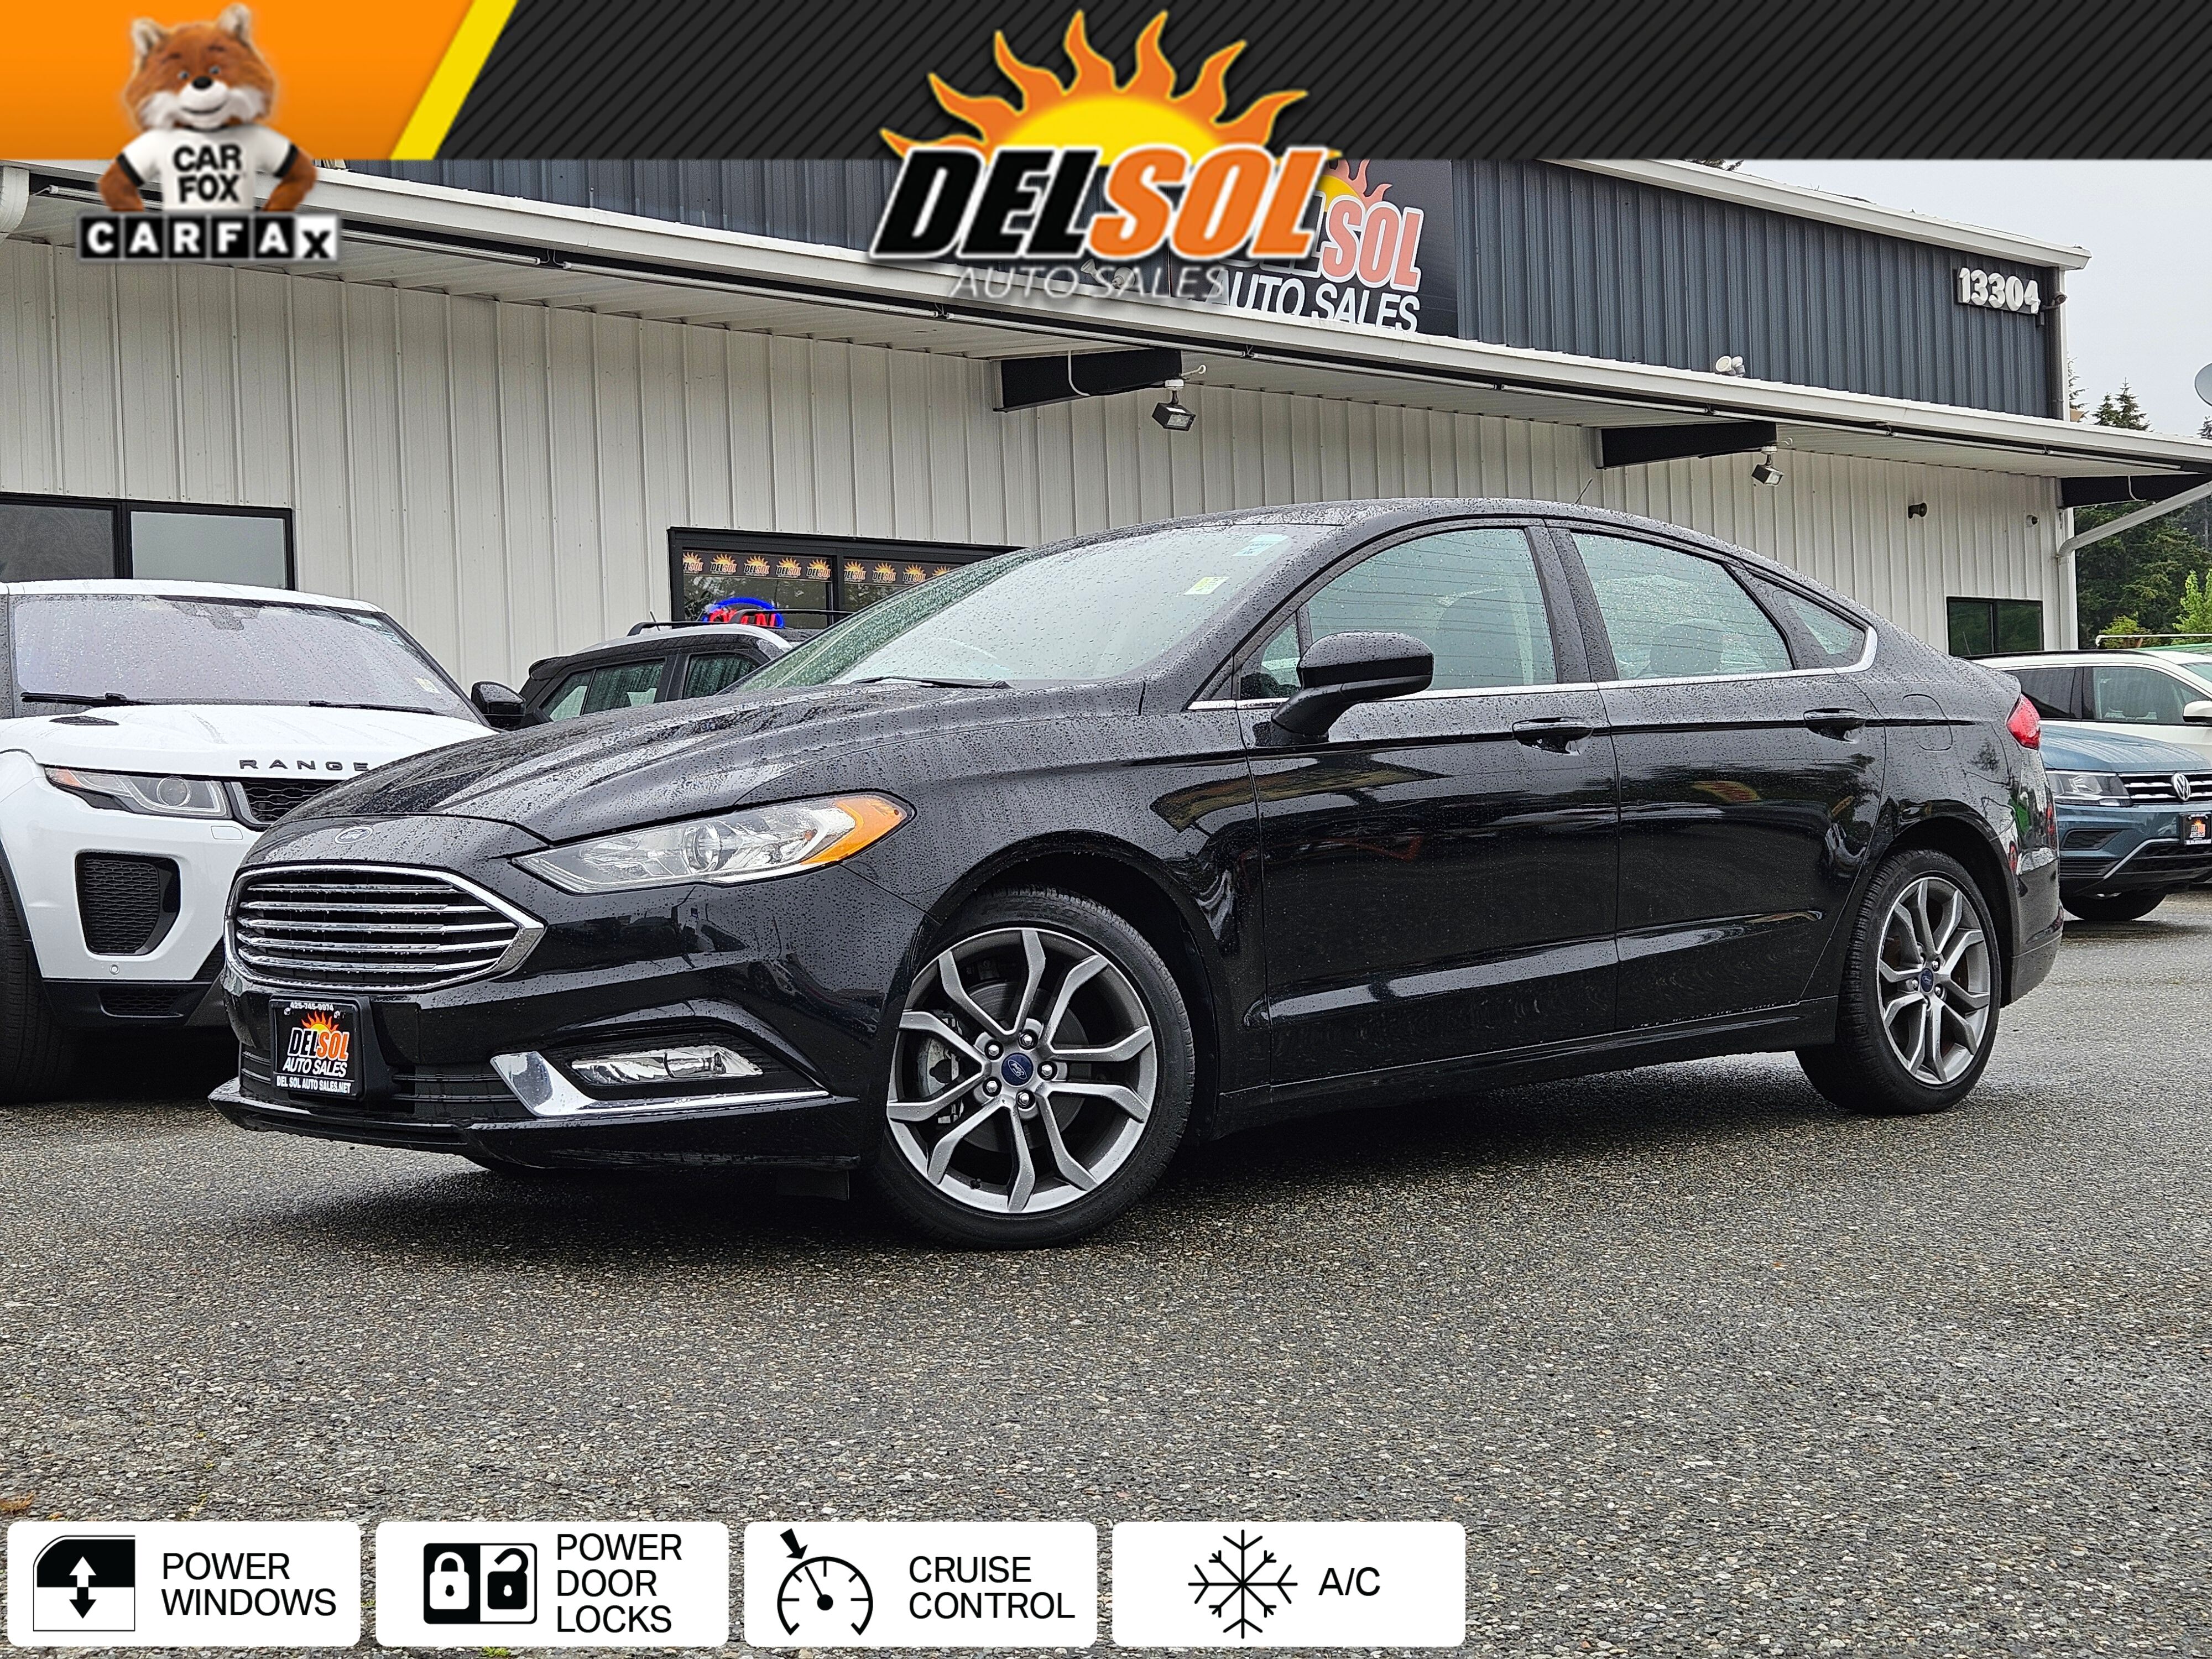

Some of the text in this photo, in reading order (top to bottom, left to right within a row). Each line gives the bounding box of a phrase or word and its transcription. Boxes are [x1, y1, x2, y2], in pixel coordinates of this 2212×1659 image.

[1206, 269, 1421, 332] AUTO SALES
[1959, 267, 2041, 314] 13304
[239, 759, 369, 771] RANGE
[282, 1057, 348, 1077] AUTO SALES
[276, 1076, 352, 1094] DEL SOL AUTO SALES.NET
